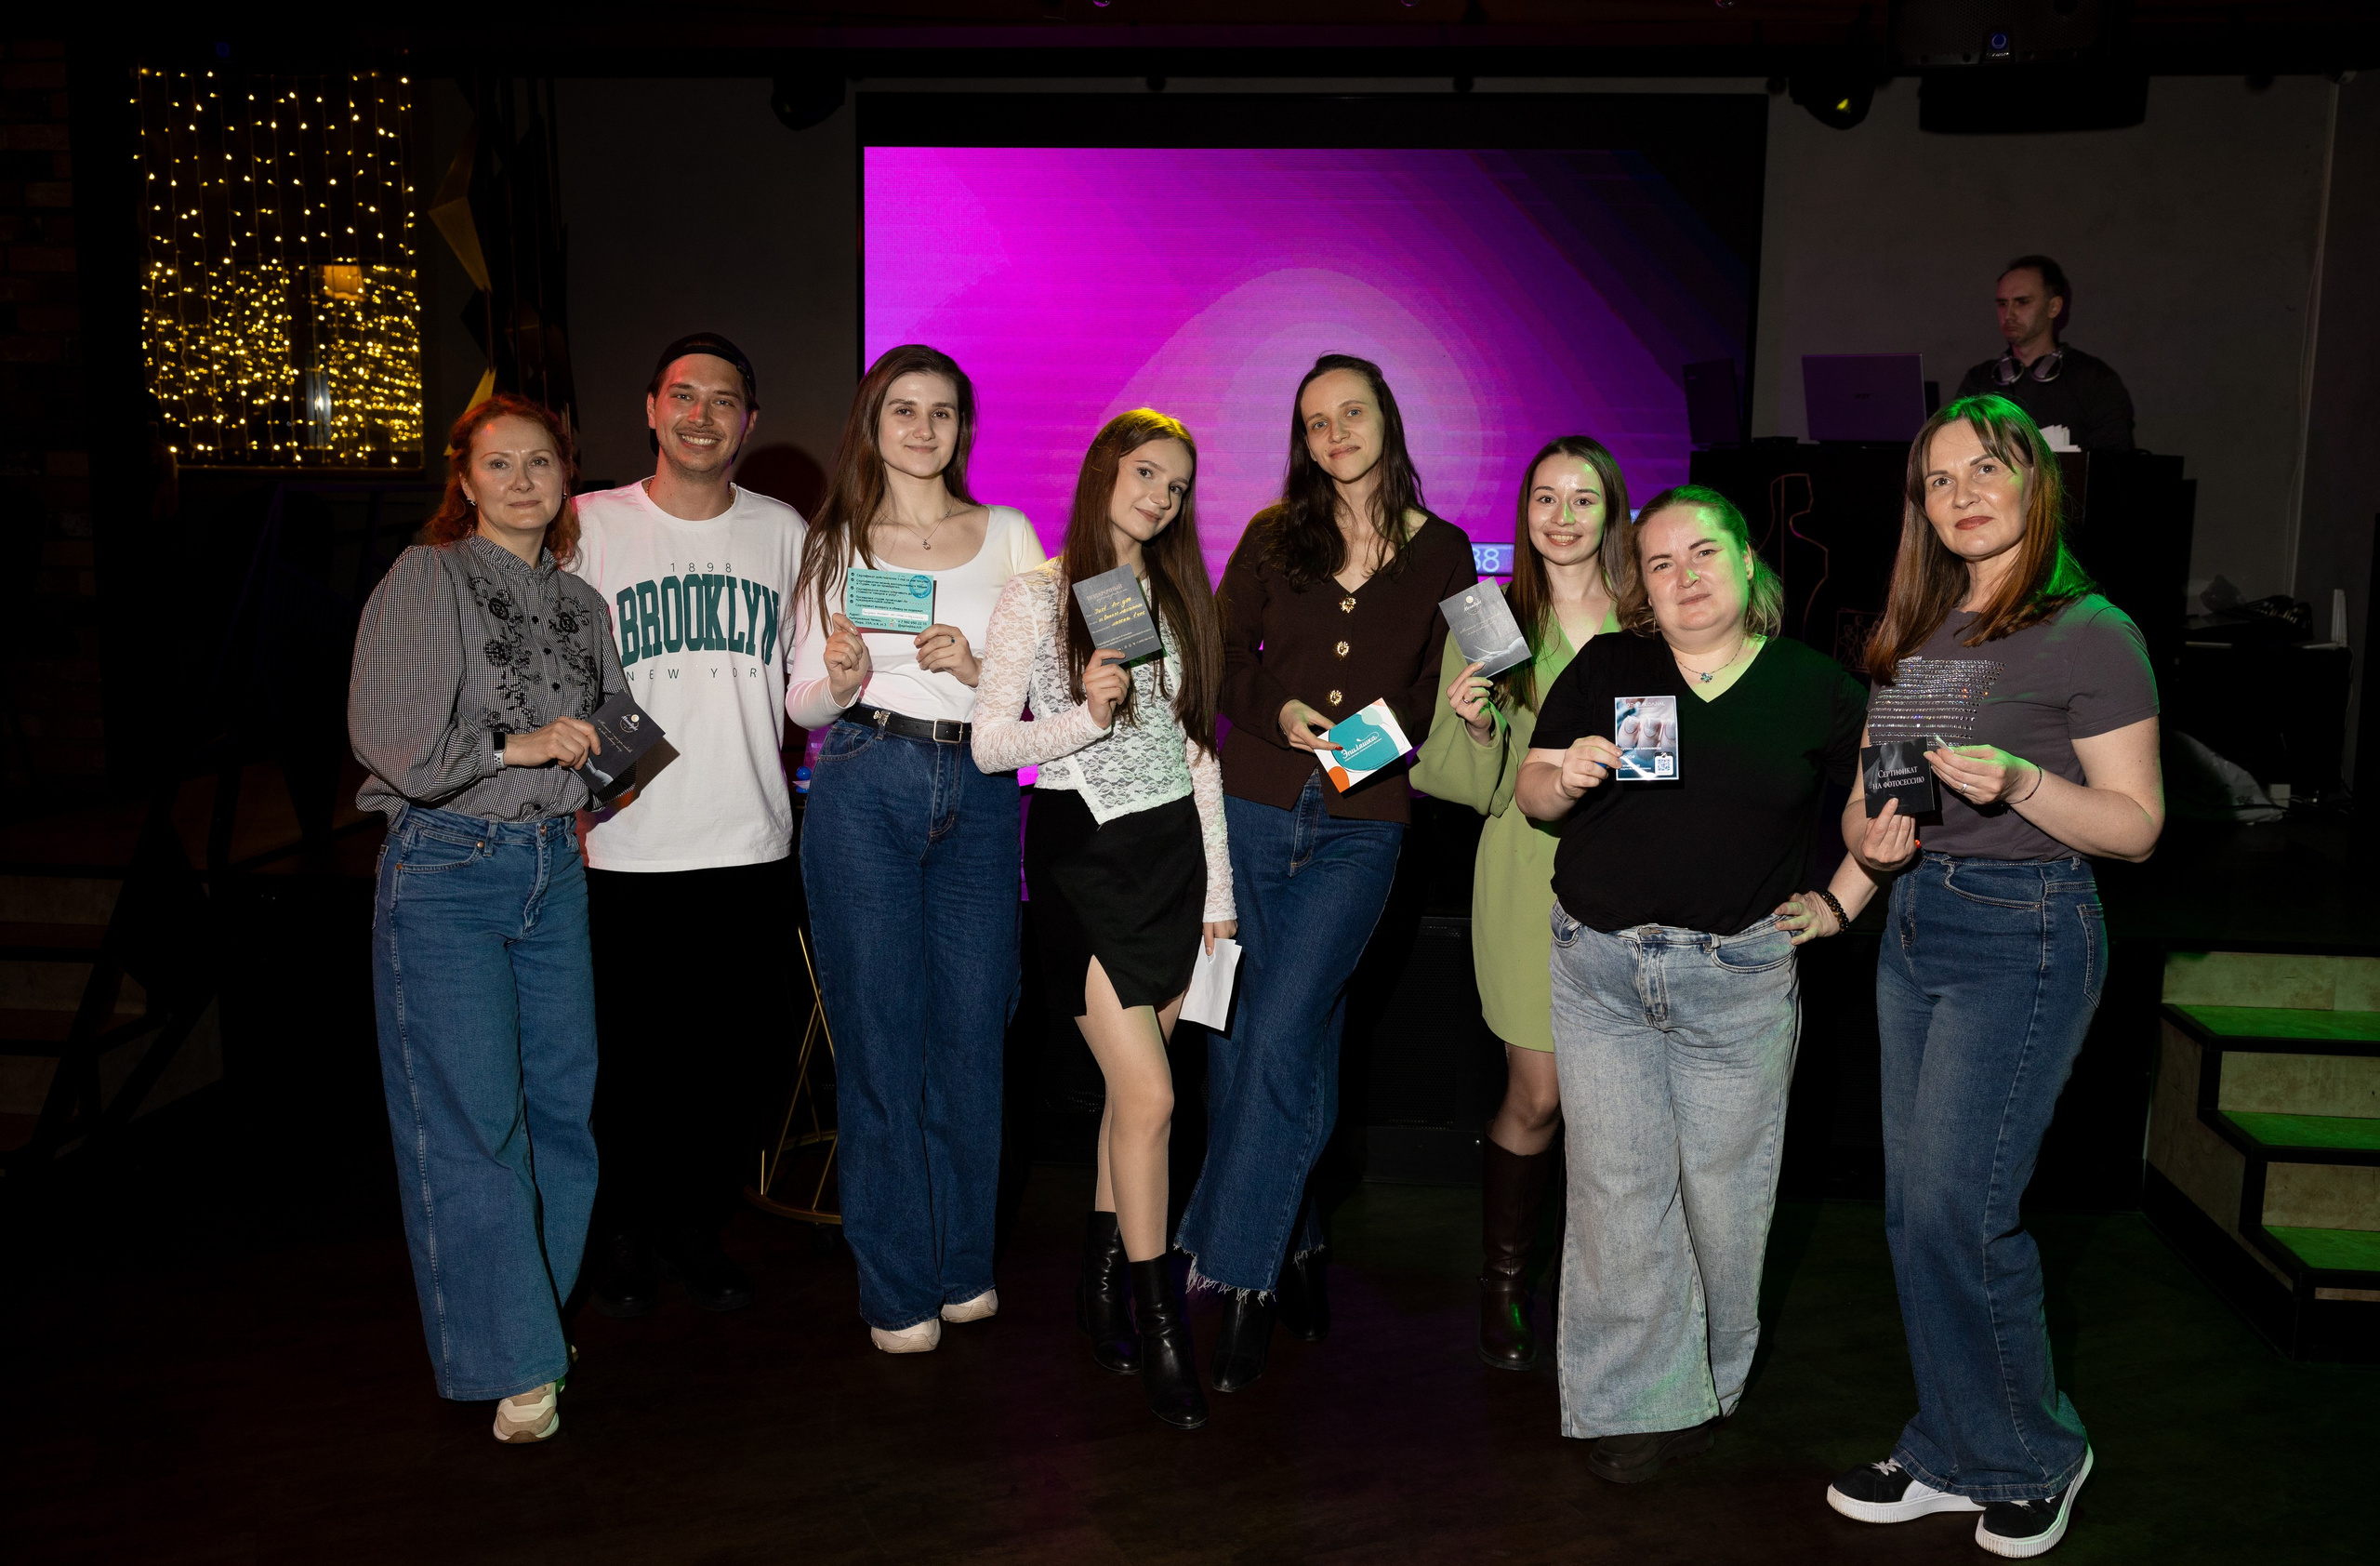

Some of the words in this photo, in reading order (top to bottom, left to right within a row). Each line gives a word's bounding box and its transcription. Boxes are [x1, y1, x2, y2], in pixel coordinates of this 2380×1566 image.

[670, 563, 732, 573] 1898
[616, 574, 779, 669] BROOKLYN
[626, 669, 680, 682] NEW
[710, 668, 757, 679] YOR
